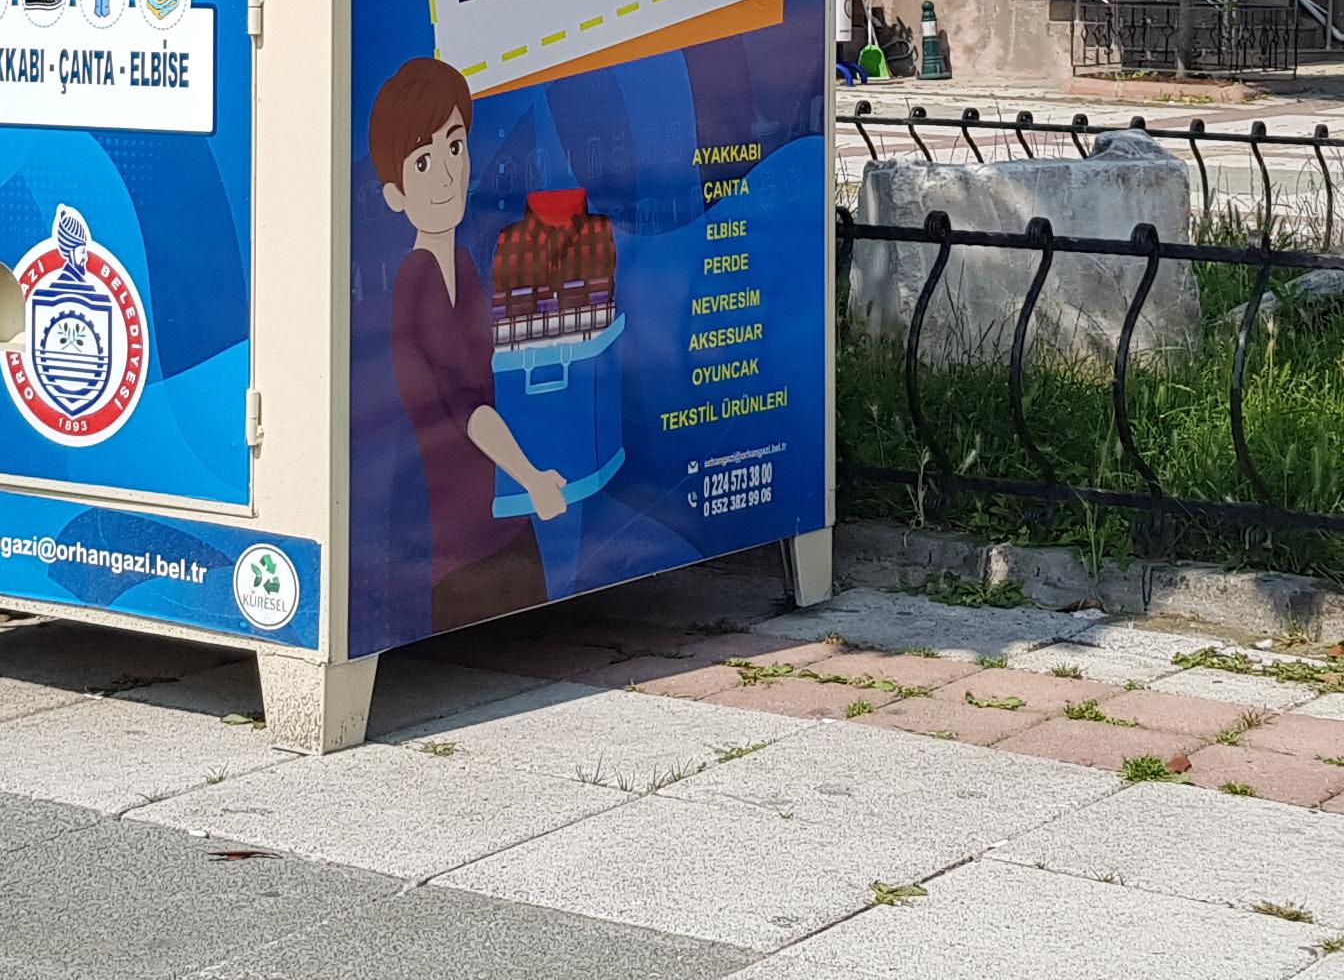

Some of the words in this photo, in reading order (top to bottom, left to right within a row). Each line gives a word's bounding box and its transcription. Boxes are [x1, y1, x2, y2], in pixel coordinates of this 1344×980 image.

[59, 48, 115, 94] ÇANTA
[130, 39, 189, 88] ELBİSE
[692, 143, 761, 165] AYAKKABI
[704, 178, 750, 202] ÇANTA
[706, 219, 747, 240] ELBİSE
[704, 253, 749, 275] PERDE
[692, 287, 760, 316] NEVRESİM
[688, 323, 762, 351] AKSESUAR
[692, 358, 759, 386] OYUNCAK
[660, 401, 718, 431] TEKSTİL
[721, 386, 788, 419] ÜRÜNLERİ
[58, 418, 88, 432] 1893
[703, 476, 710, 498] 0
[711, 471, 729, 496] 224
[730, 467, 747, 491] 573
[749, 465, 760, 487] 38
[761, 462, 772, 484] 00
[703, 501, 710, 517] 0
[711, 497, 728, 515] 552
[730, 493, 747, 510] 382
[748, 490, 759, 506] 99
[242, 590, 288, 613] KÜRESEL
